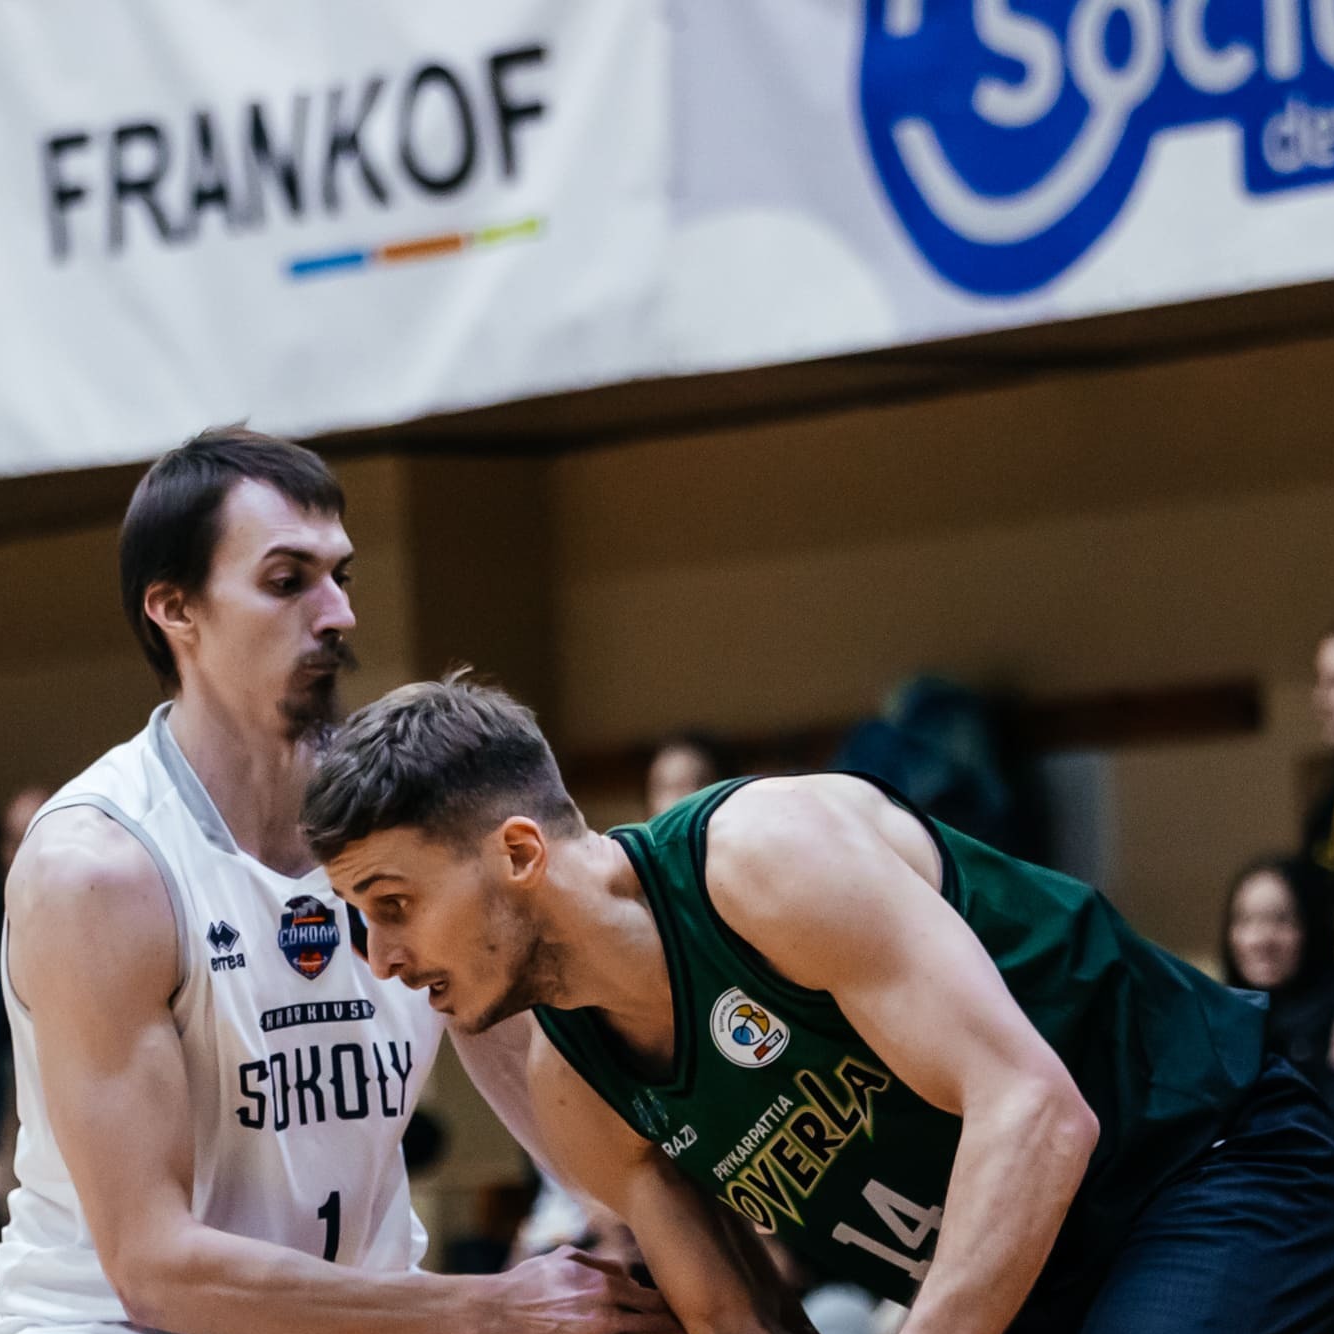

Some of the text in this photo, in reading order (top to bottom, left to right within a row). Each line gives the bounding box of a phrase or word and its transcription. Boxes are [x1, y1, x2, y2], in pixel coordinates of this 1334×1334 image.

[42, 45, 548, 263] FRANKOF
[211, 953, 246, 972] errea
[236, 1041, 412, 1131] SOKOLY
[712, 1094, 794, 1182] PRYKARPATTIA
[717, 1056, 890, 1234] OVERLA
[318, 1191, 340, 1263] 1
[831, 1178, 944, 1282] 14
